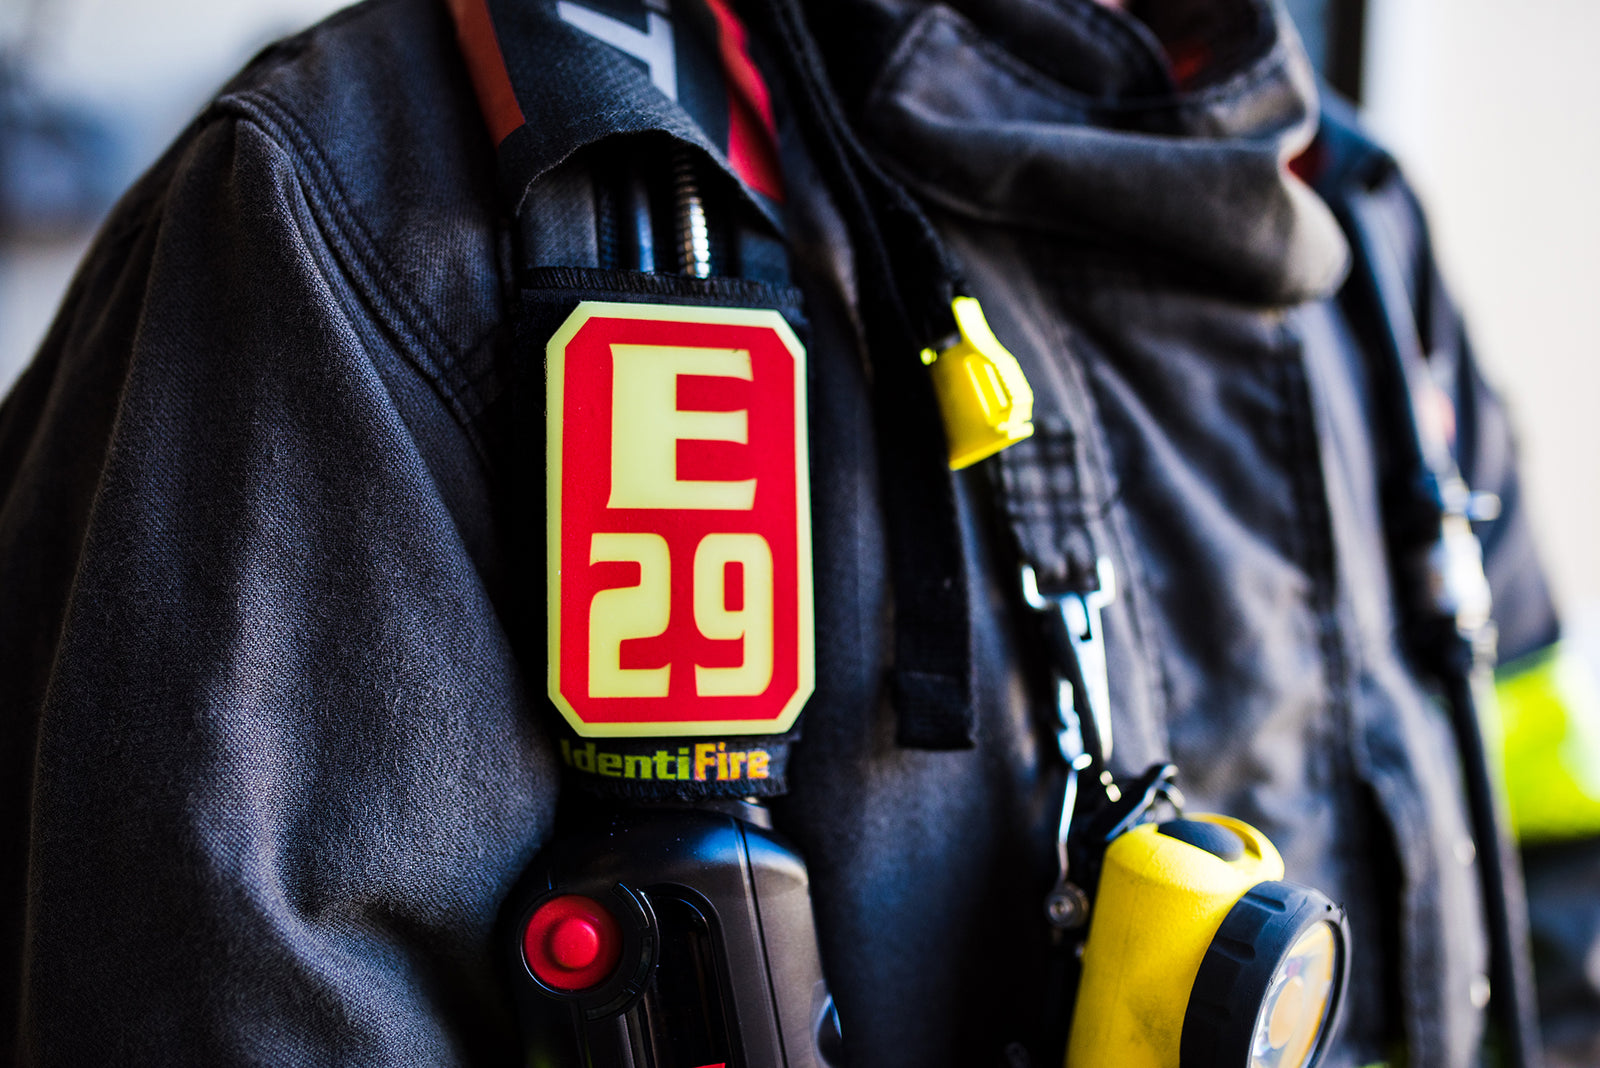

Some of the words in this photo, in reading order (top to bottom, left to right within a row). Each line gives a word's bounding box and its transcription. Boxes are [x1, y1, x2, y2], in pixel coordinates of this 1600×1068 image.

[606, 343, 757, 511] E
[588, 532, 774, 699] 29
[560, 739, 771, 781] IdentiFire
